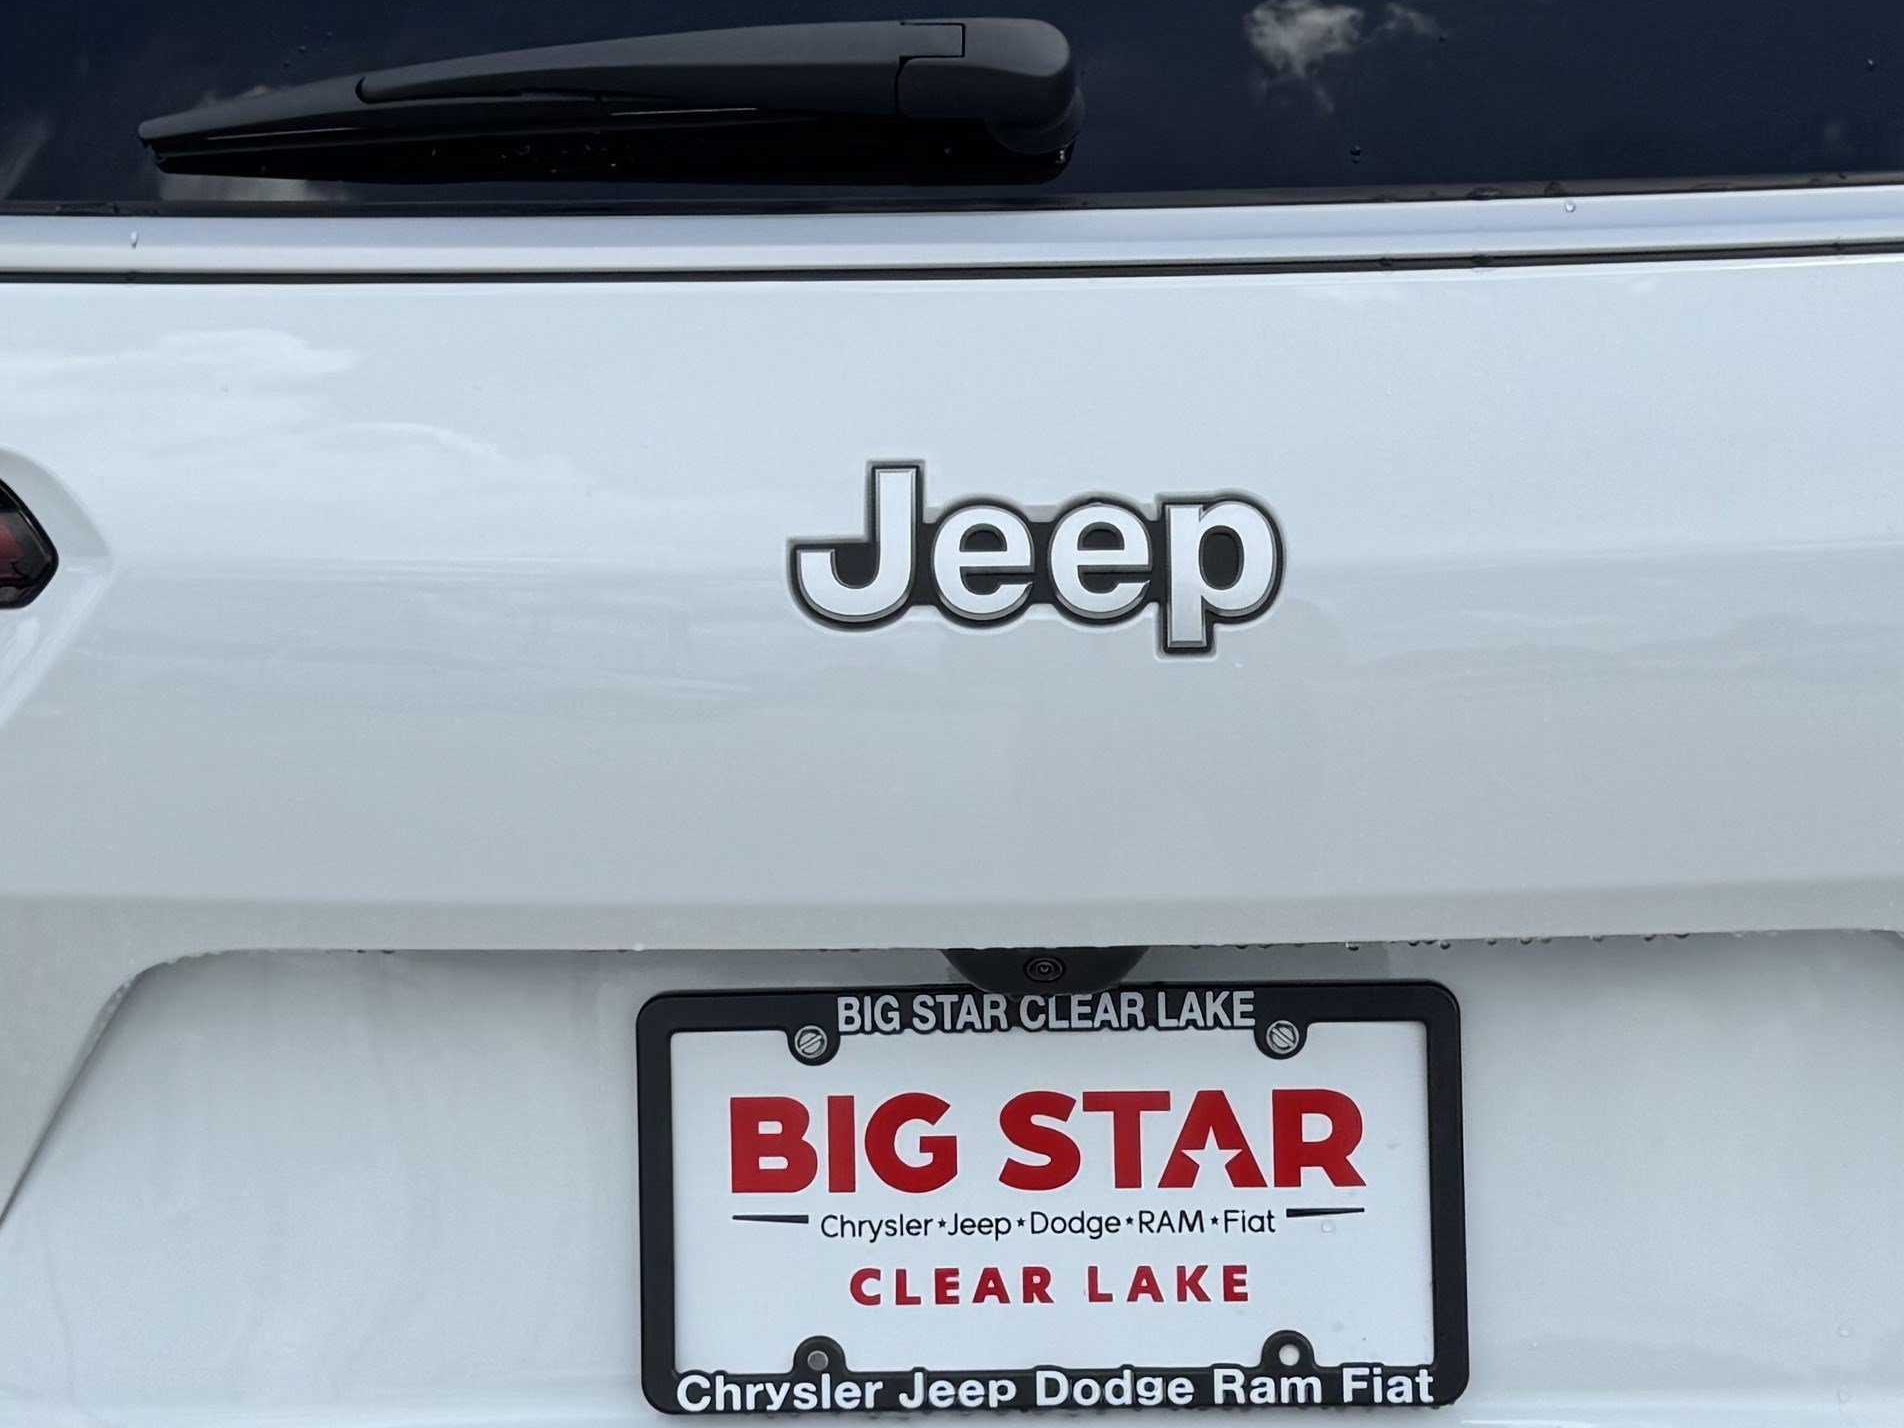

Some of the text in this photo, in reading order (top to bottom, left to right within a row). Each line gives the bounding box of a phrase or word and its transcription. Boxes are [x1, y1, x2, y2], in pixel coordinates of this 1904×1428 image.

[796, 465, 1277, 653] Jeep
[837, 990, 1256, 1032] BIG STAR CLEAR LAKE
[731, 1089, 1366, 1194] BIG STAR
[821, 1210, 1276, 1243] Chrysler Jeep Dodge RAM Fiat
[851, 1264, 1250, 1307] CLEAR LAKE
[676, 1366, 1434, 1412] Chrysler Jeep Dodge Ram Fiat
